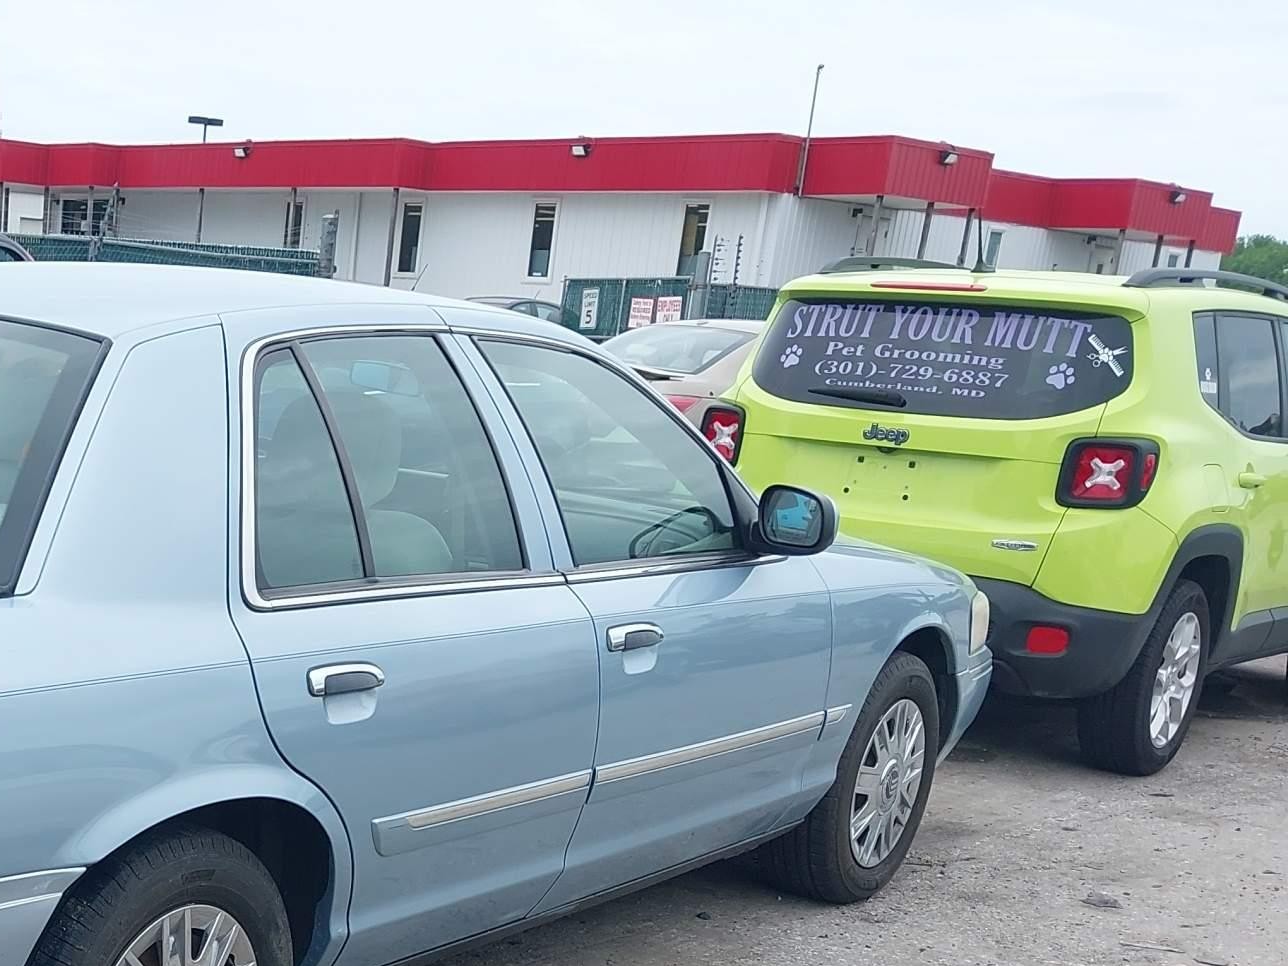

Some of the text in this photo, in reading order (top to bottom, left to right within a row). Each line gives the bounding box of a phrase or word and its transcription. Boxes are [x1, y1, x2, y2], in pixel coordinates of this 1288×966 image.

[585, 310, 592, 324] 5
[786, 303, 1093, 358] STRUT YOUR MUTT
[825, 341, 1008, 370] Pet Grooming
[814, 359, 1009, 389] (301)-729-6887
[951, 387, 986, 398] MD
[862, 422, 910, 446] Jeep
